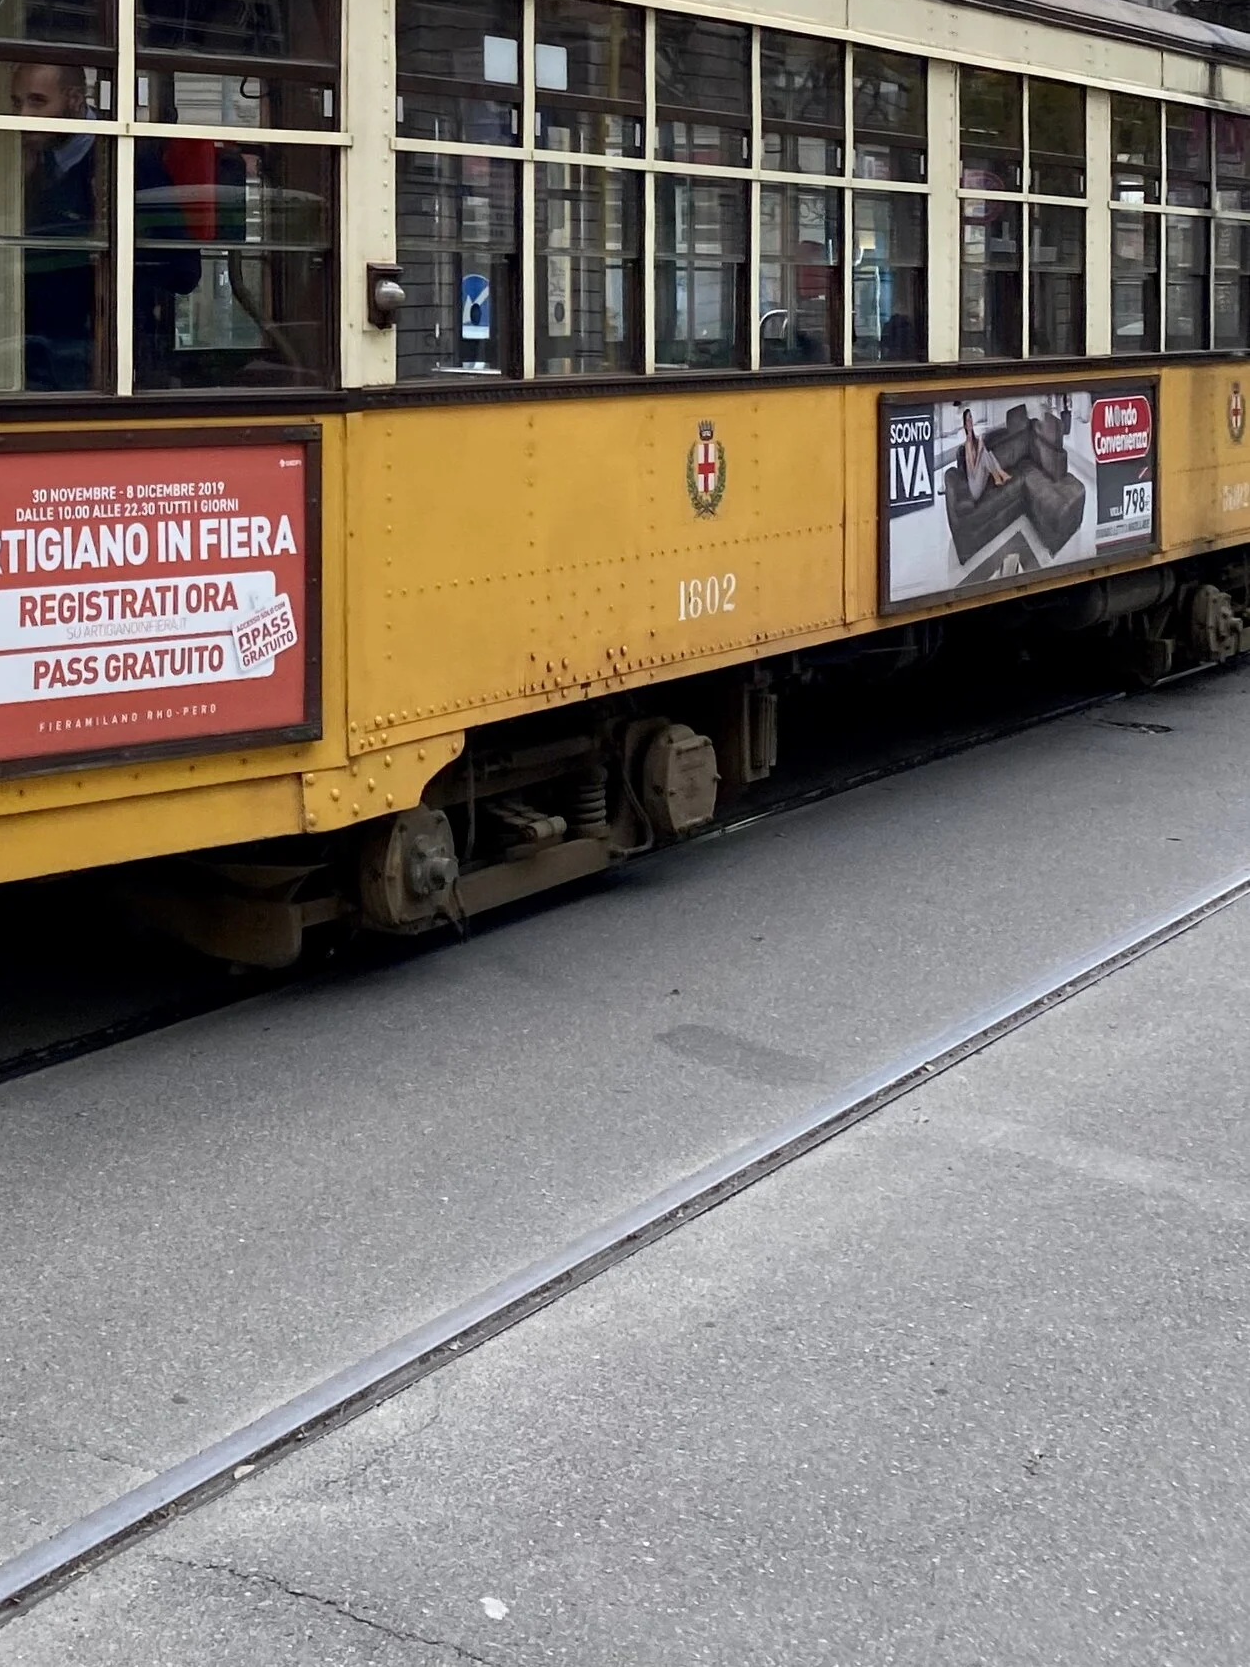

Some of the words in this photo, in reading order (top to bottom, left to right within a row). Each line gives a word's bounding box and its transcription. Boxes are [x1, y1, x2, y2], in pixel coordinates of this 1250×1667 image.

[890, 421, 931, 444] SCONTO
[1095, 427, 1148, 455] Convenienza
[890, 445, 932, 500] IVA
[32, 489, 47, 503] 30
[50, 486, 117, 502] NOVEMBRE
[126, 485, 134, 499] 8
[137, 482, 195, 498] DICEMBRE
[198, 481, 225, 496] 2019
[16, 507, 54, 522] DALLE
[58, 505, 90, 520] 10.00
[93, 503, 121, 518] ALLE
[124, 502, 155, 517] 22.30
[158, 500, 191, 515] TUTTI
[194, 500, 198, 513] I
[201, 498, 239, 513] GIORNI
[157, 520, 191, 562] IN
[200, 514, 297, 560] FIERA
[19, 584, 179, 628] REGISTRATI
[185, 581, 239, 613] ORA
[678, 573, 736, 621] 1602
[66, 625, 82, 640] SU
[237, 615, 261, 632] ACCESSO
[251, 611, 290, 646] PASS
[243, 630, 294, 667] GRATUITO
[33, 655, 99, 689] PASS
[105, 644, 224, 682] GRATUITO
[39, 712, 138, 733] FIERAMILANO
[147, 703, 217, 720] RHO-PERO
